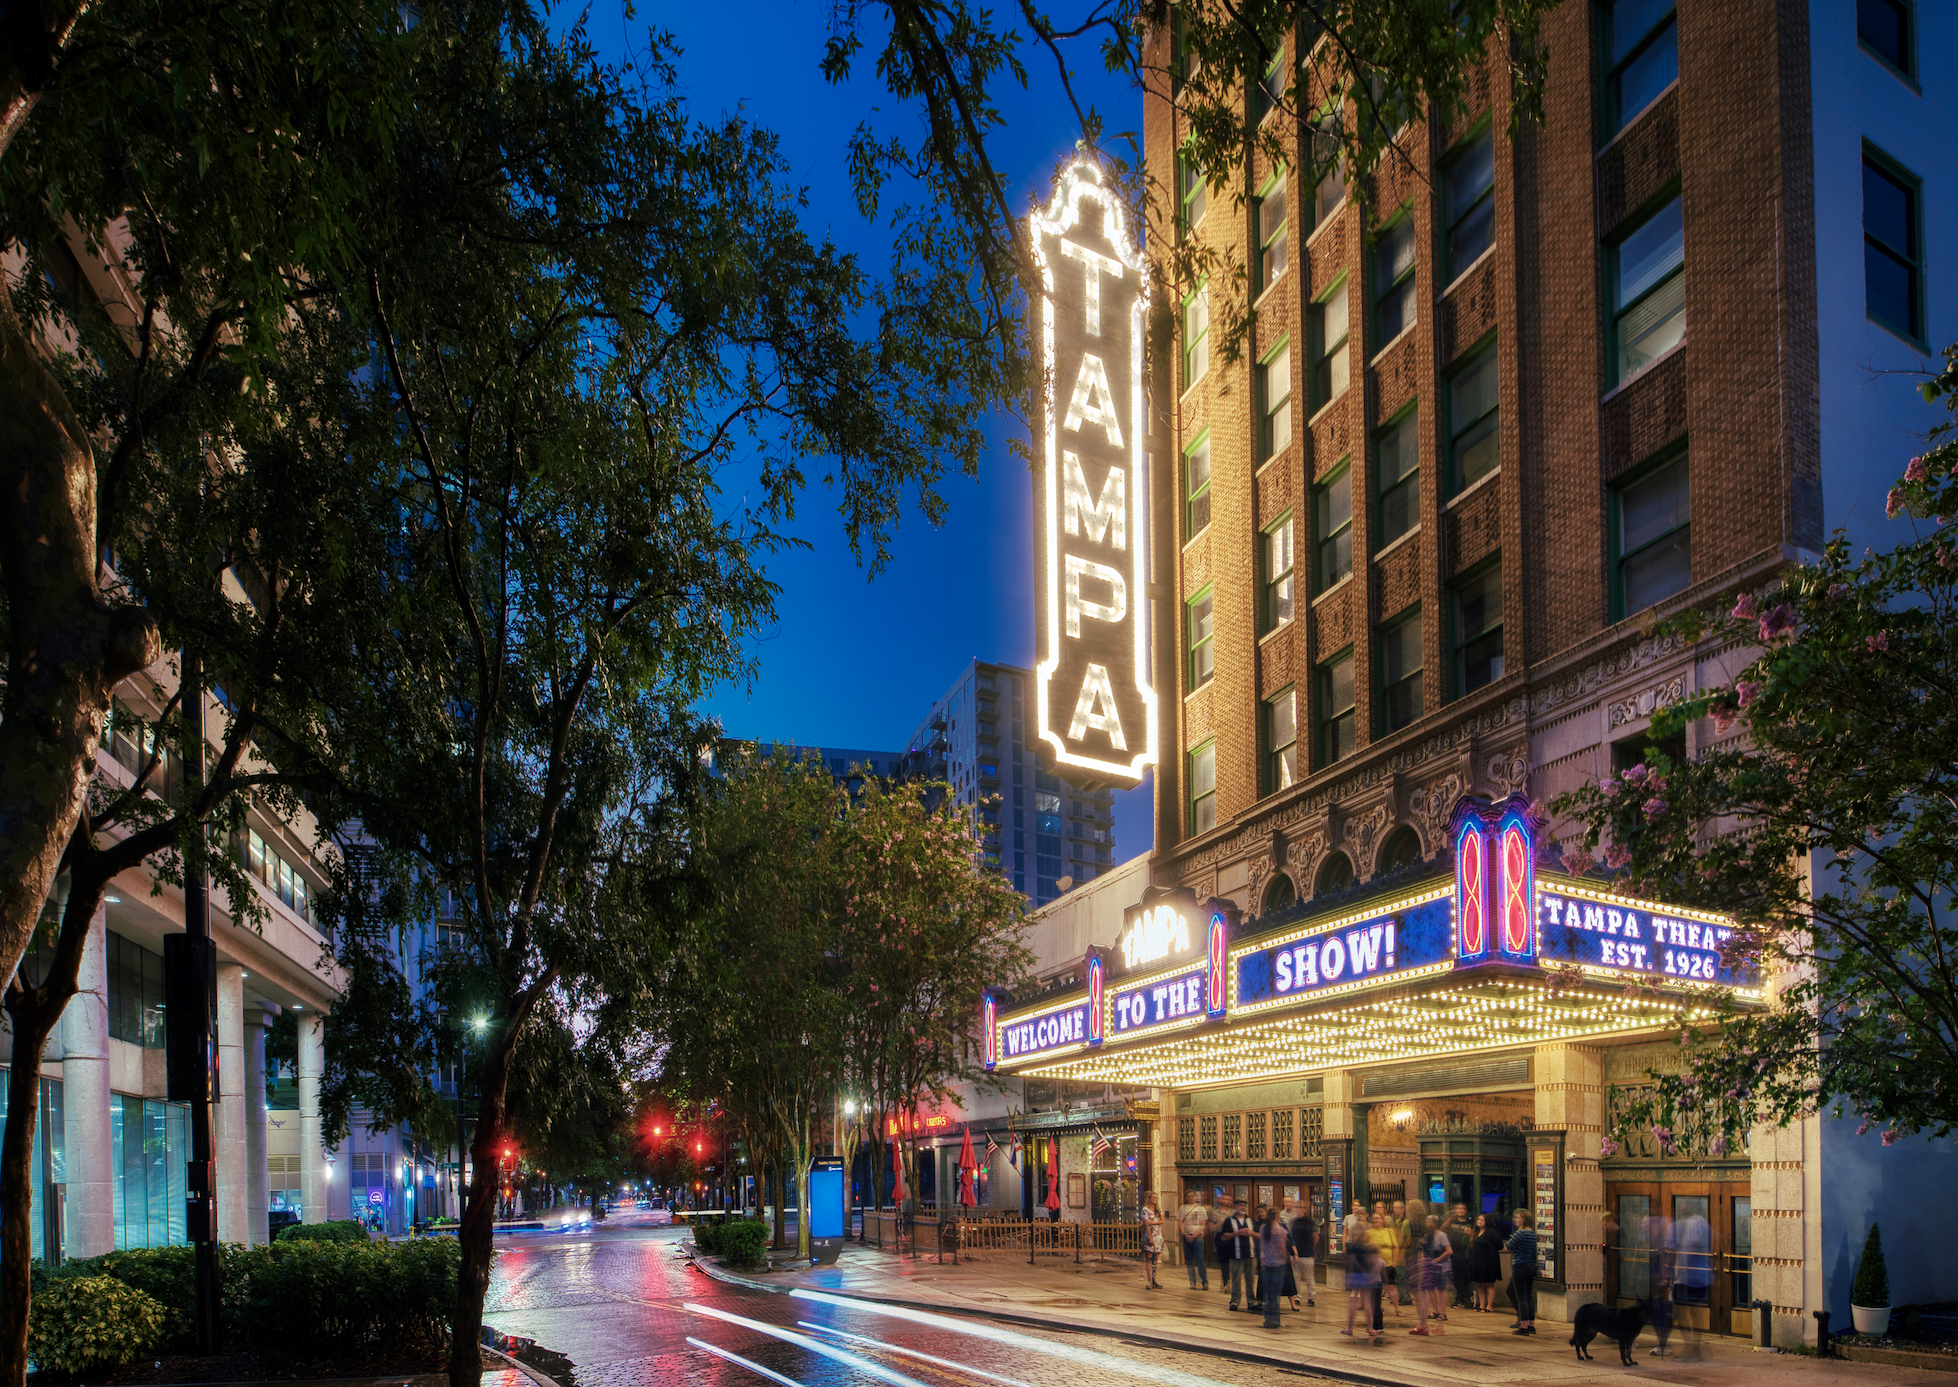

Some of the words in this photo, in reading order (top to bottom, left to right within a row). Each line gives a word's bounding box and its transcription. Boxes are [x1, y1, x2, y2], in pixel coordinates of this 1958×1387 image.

[1061, 237, 1127, 751] TAMPA
[1121, 905, 1190, 969] TAMPA
[1545, 897, 1640, 937] TAMPA
[1652, 917, 1732, 949] THEAT
[1275, 921, 1395, 991] SHOW!
[1601, 939, 1653, 970] EST.
[1665, 950, 1715, 979] 1926
[1117, 992, 1146, 1030] TO
[1152, 976, 1201, 1022] THE
[1007, 1009, 1084, 1055] WELCOME
